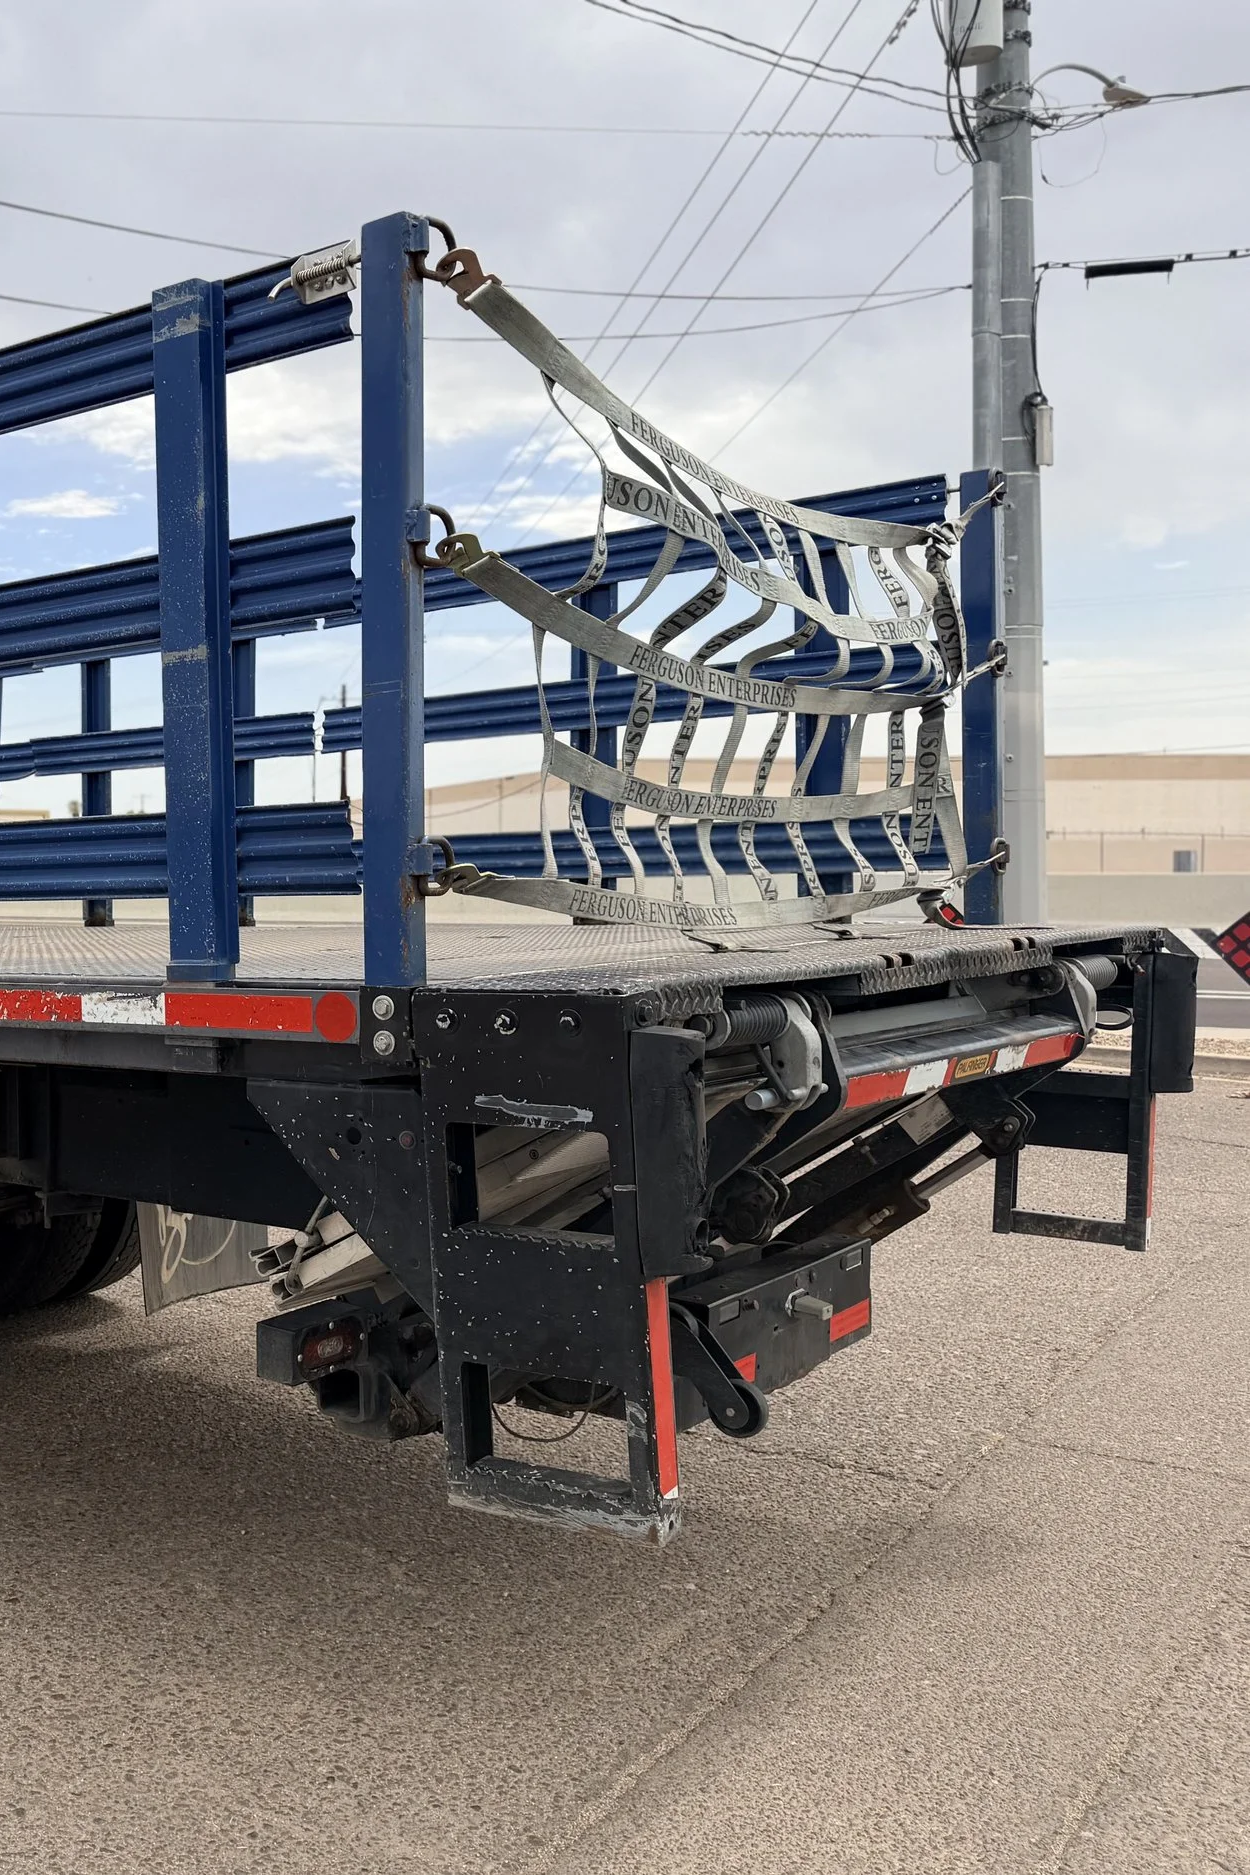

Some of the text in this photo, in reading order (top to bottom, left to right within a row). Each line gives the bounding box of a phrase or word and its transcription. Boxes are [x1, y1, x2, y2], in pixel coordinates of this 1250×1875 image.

[630, 411, 800, 525] FERGUSON ENTERPRISES
[628, 644, 798, 708] FERGUSON ENTERPRISES
[693, 794, 778, 819] ENTERPRISES
[567, 889, 738, 927] FERGUSON ENTERPRISES
